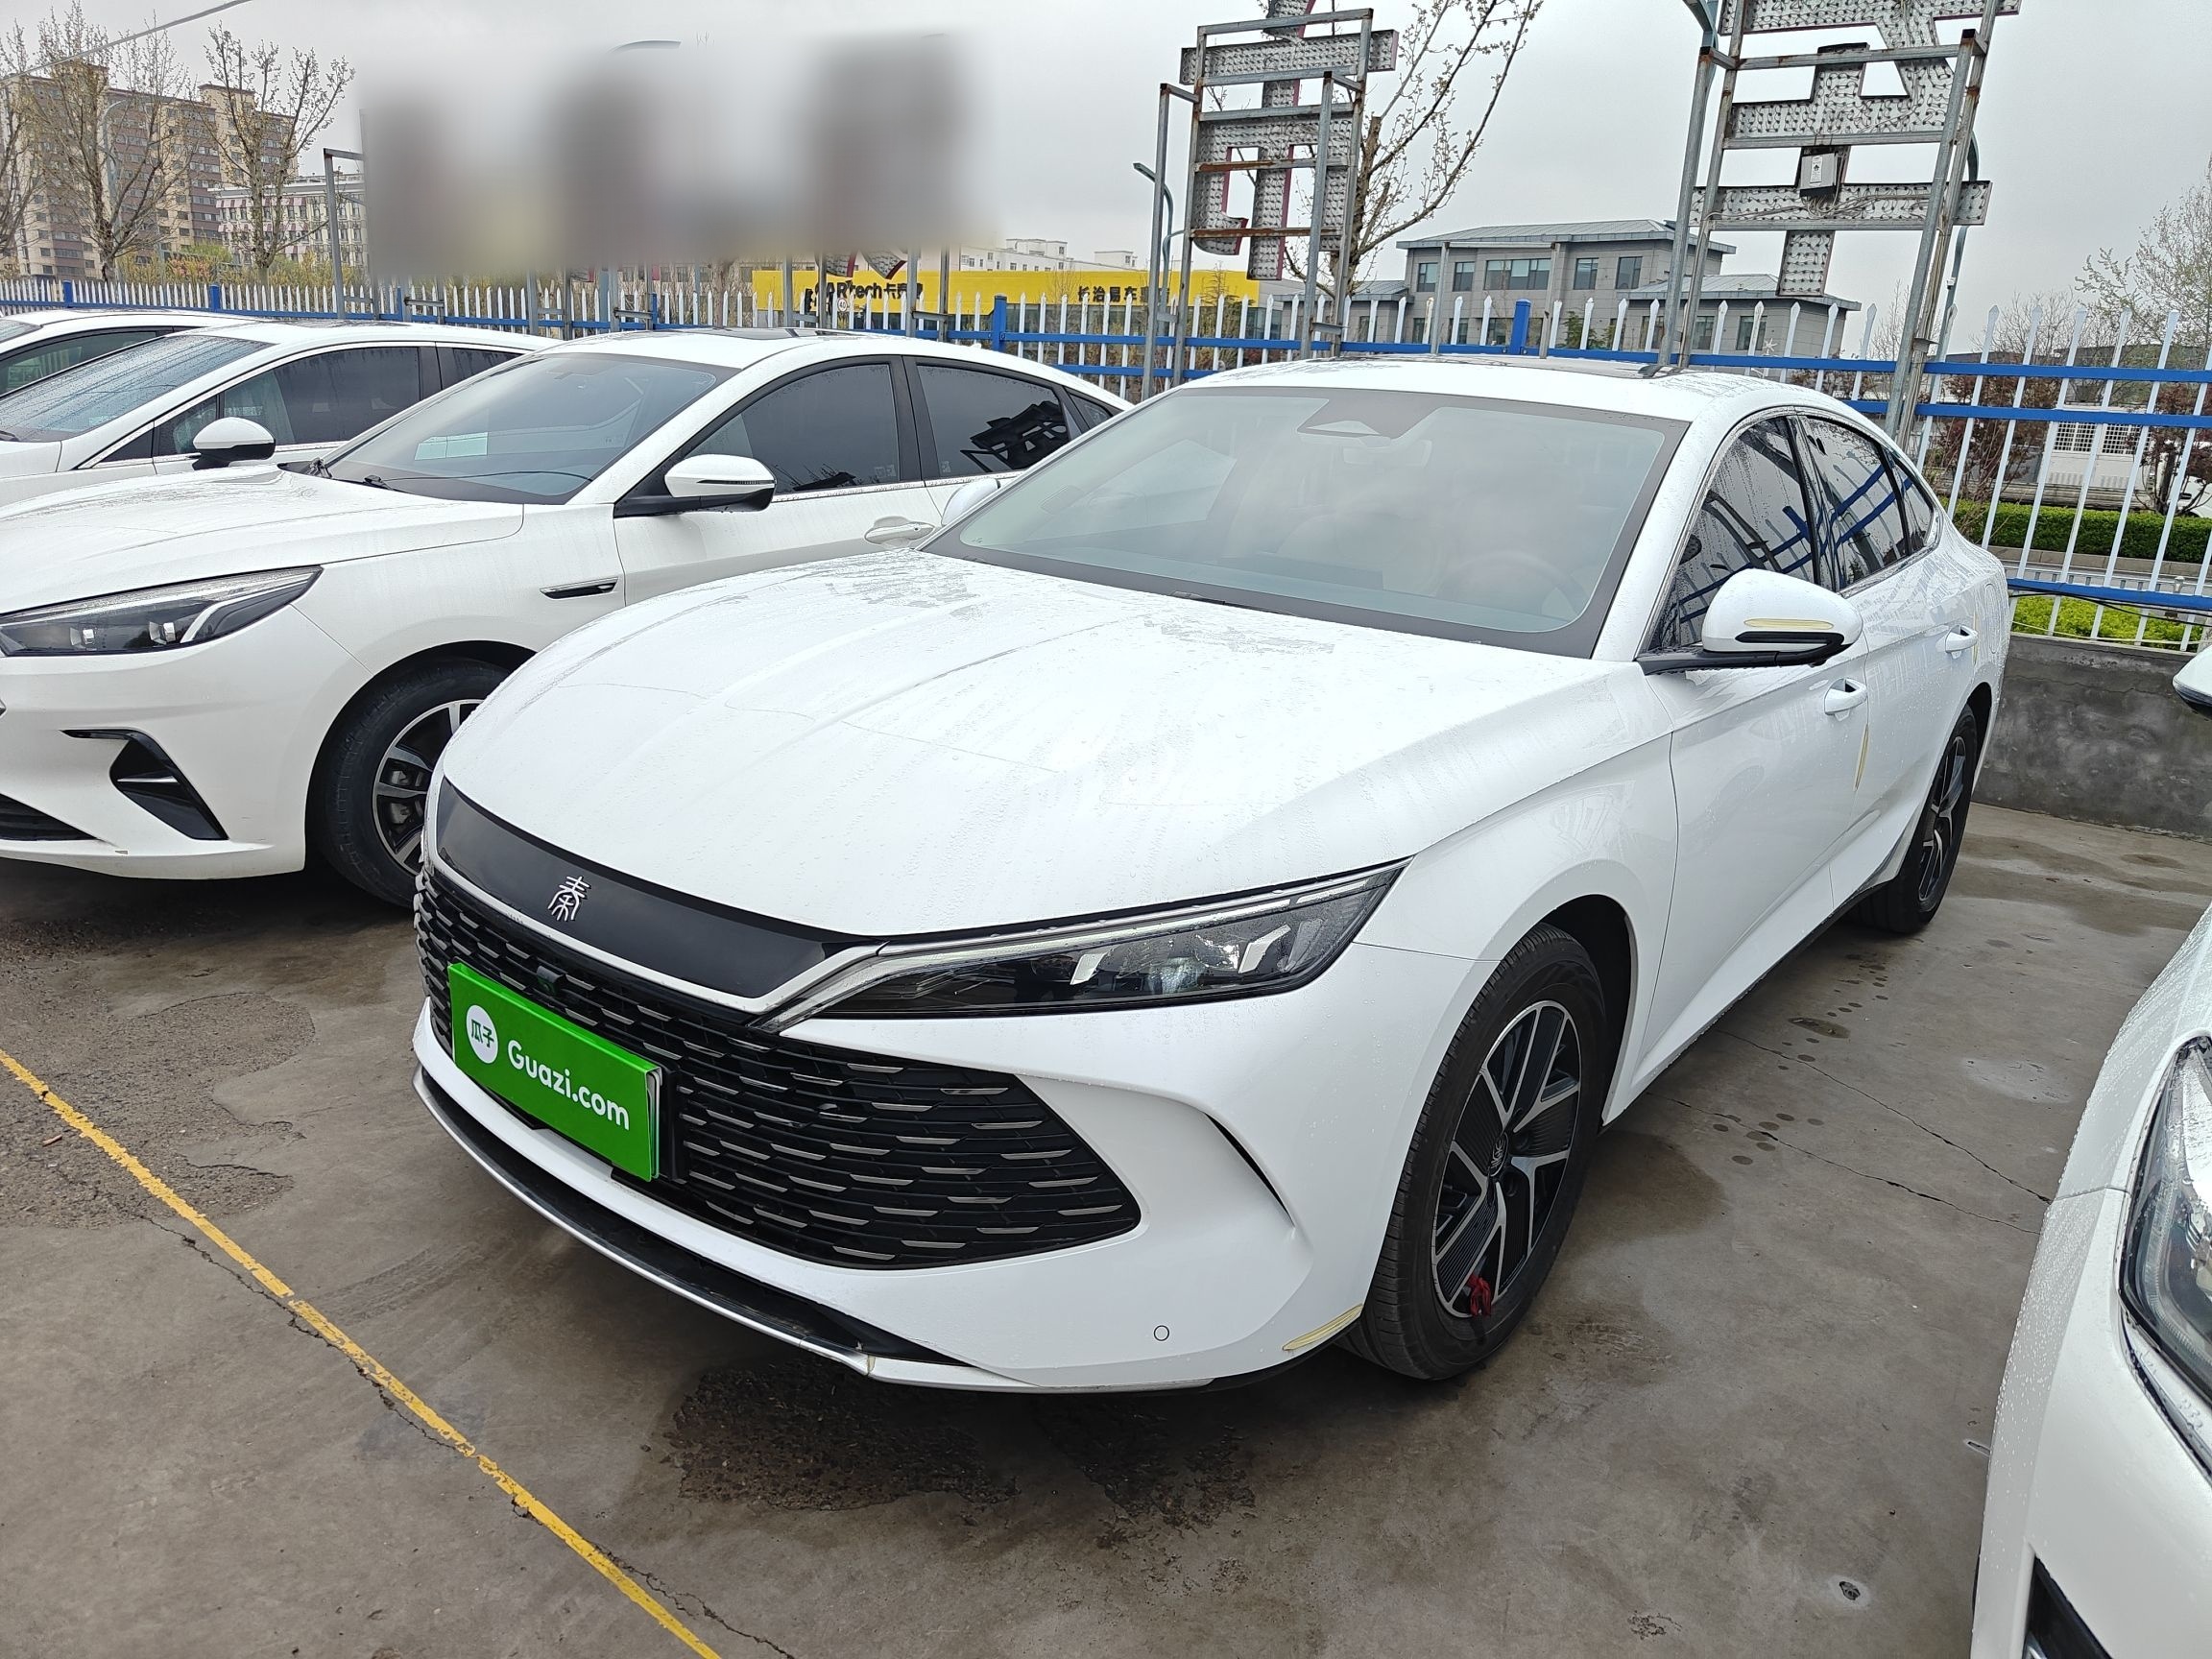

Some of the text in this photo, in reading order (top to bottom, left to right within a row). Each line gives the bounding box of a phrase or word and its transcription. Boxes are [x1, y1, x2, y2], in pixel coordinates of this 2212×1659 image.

[1077, 285, 1170, 303] 长治易车
[547, 876, 590, 922] 秦
[470, 1019, 494, 1048] 瓜子
[507, 1039, 630, 1131] Guazi.com
